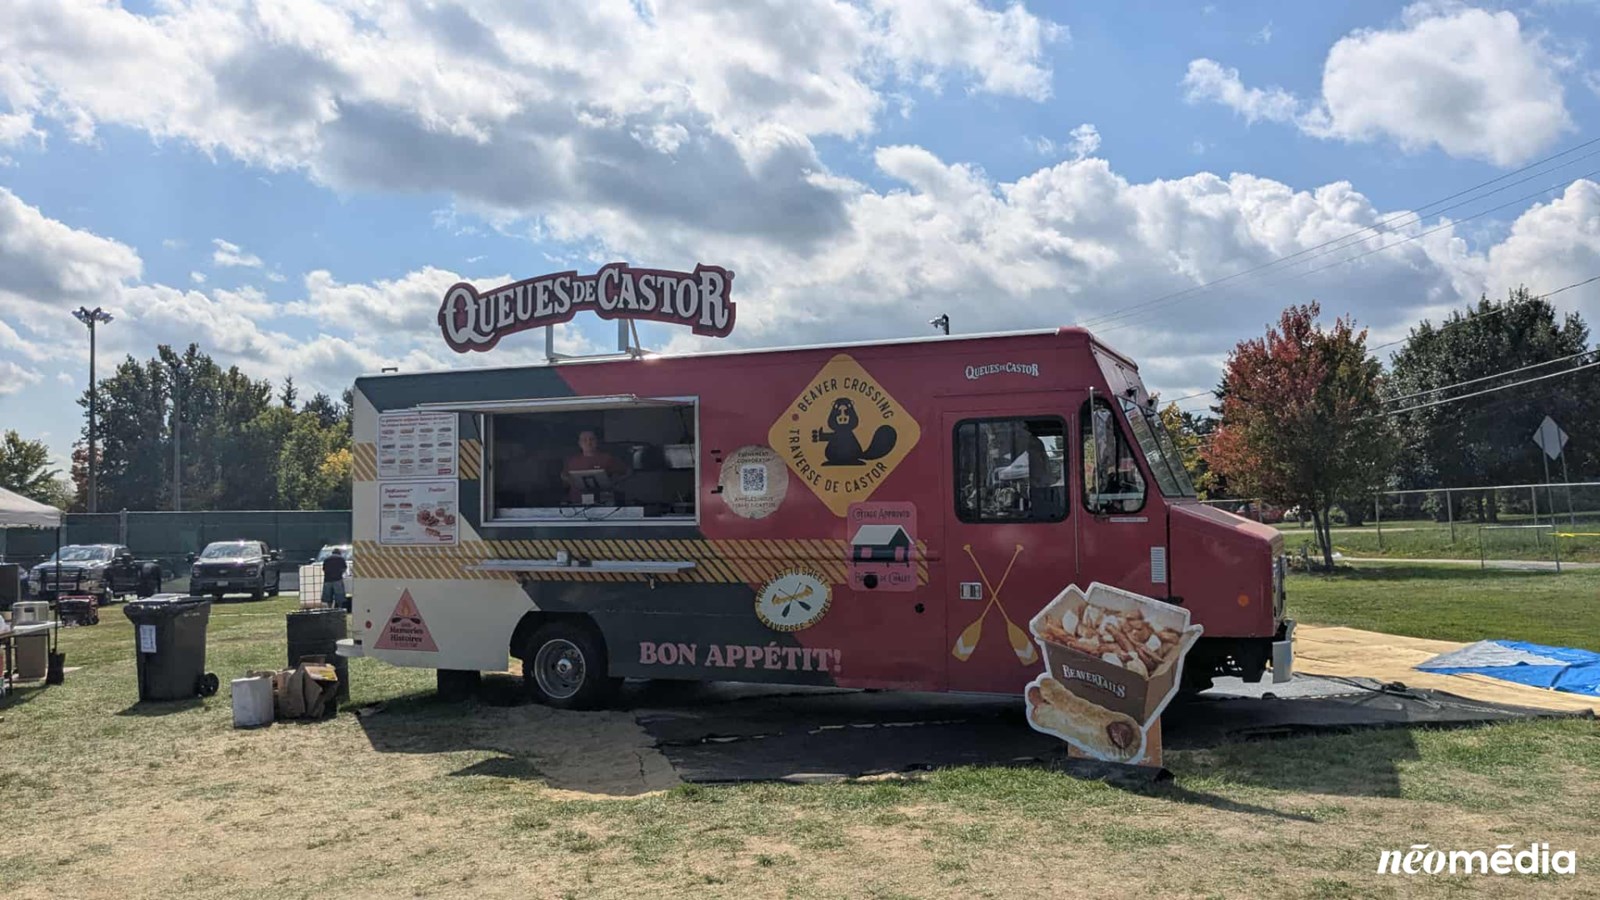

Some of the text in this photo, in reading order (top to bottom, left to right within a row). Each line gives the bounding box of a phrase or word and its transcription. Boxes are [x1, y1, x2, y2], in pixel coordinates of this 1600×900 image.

[443, 268, 728, 344] QUEUES DE CASTOR
[798, 377, 894, 419] BEAVER CROSSING
[789, 429, 887, 493] TRAVERSE DE CASTOR
[639, 641, 842, 673] BON APPÉTIT!
